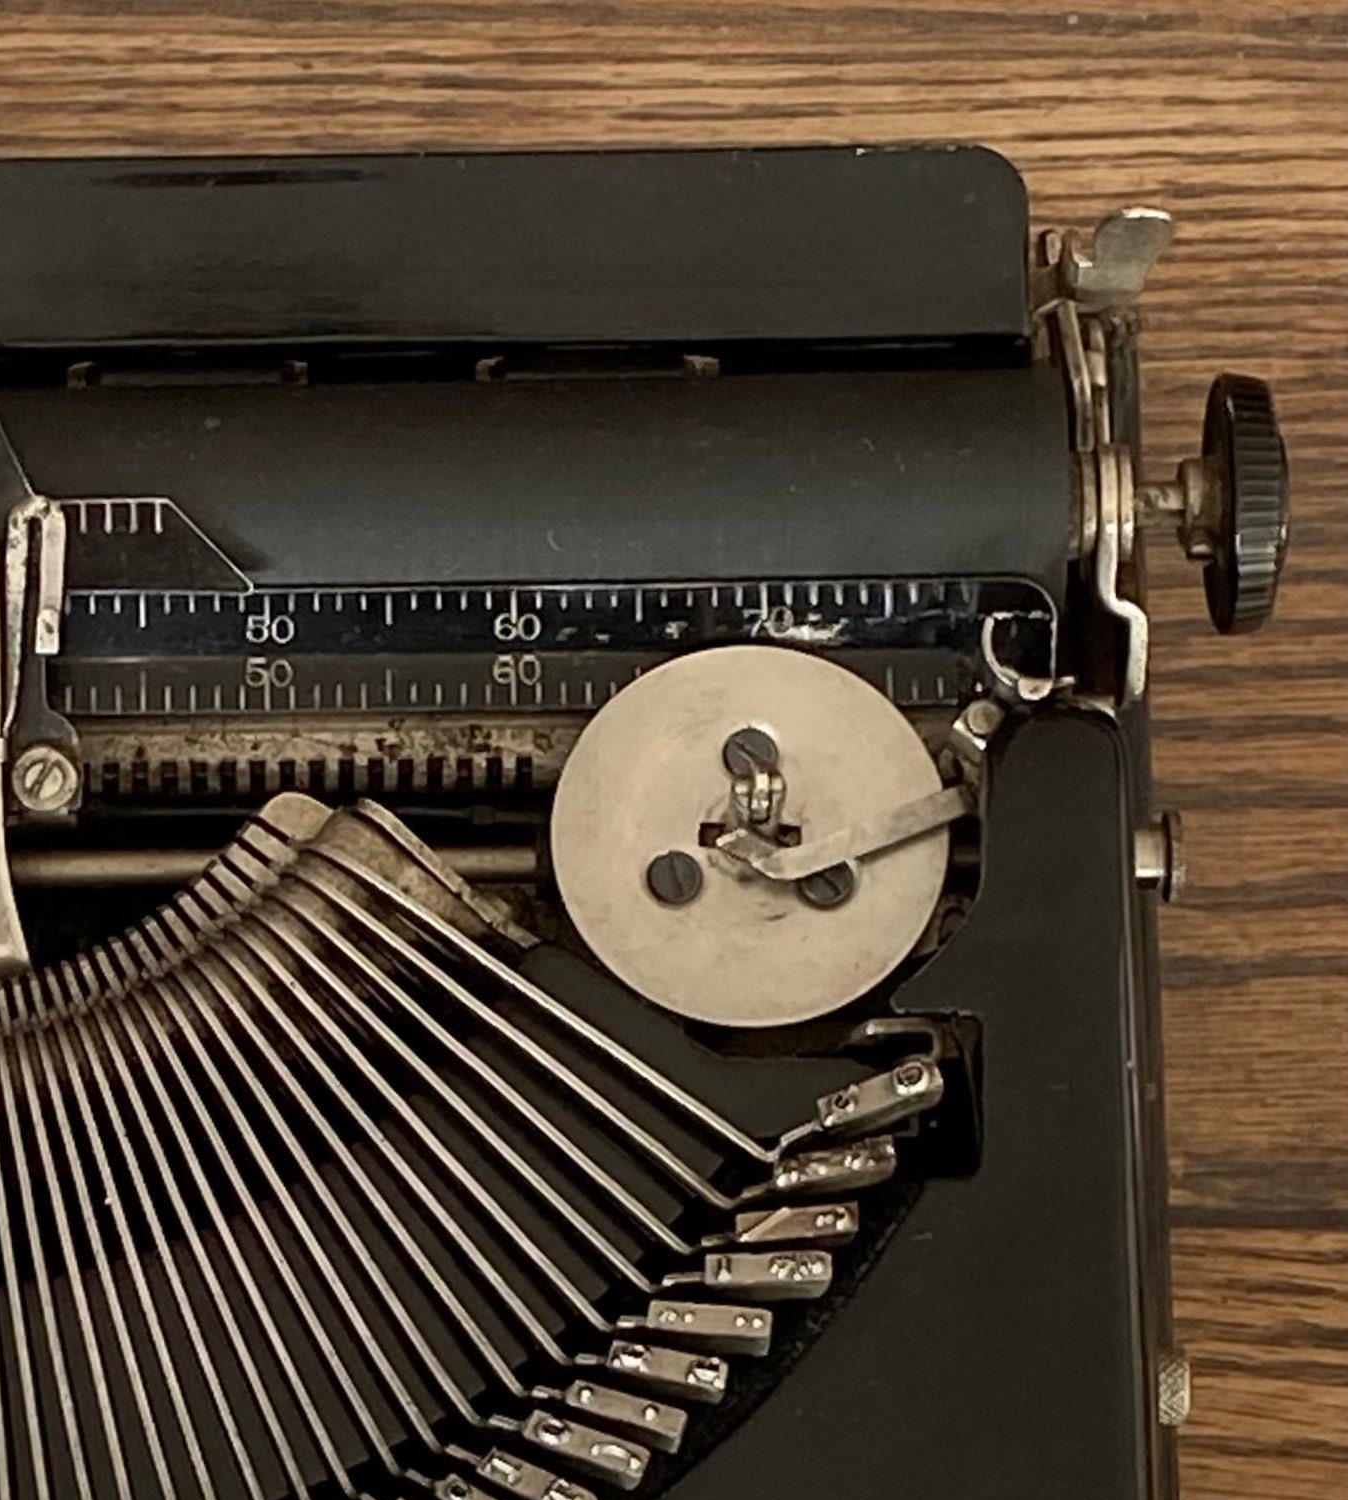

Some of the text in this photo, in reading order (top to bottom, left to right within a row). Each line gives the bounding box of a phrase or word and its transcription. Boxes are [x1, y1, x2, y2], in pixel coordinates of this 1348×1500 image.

[245, 615, 295, 646] 50
[493, 613, 542, 643] 60
[244, 658, 293, 689] 50
[492, 656, 542, 686] 60
